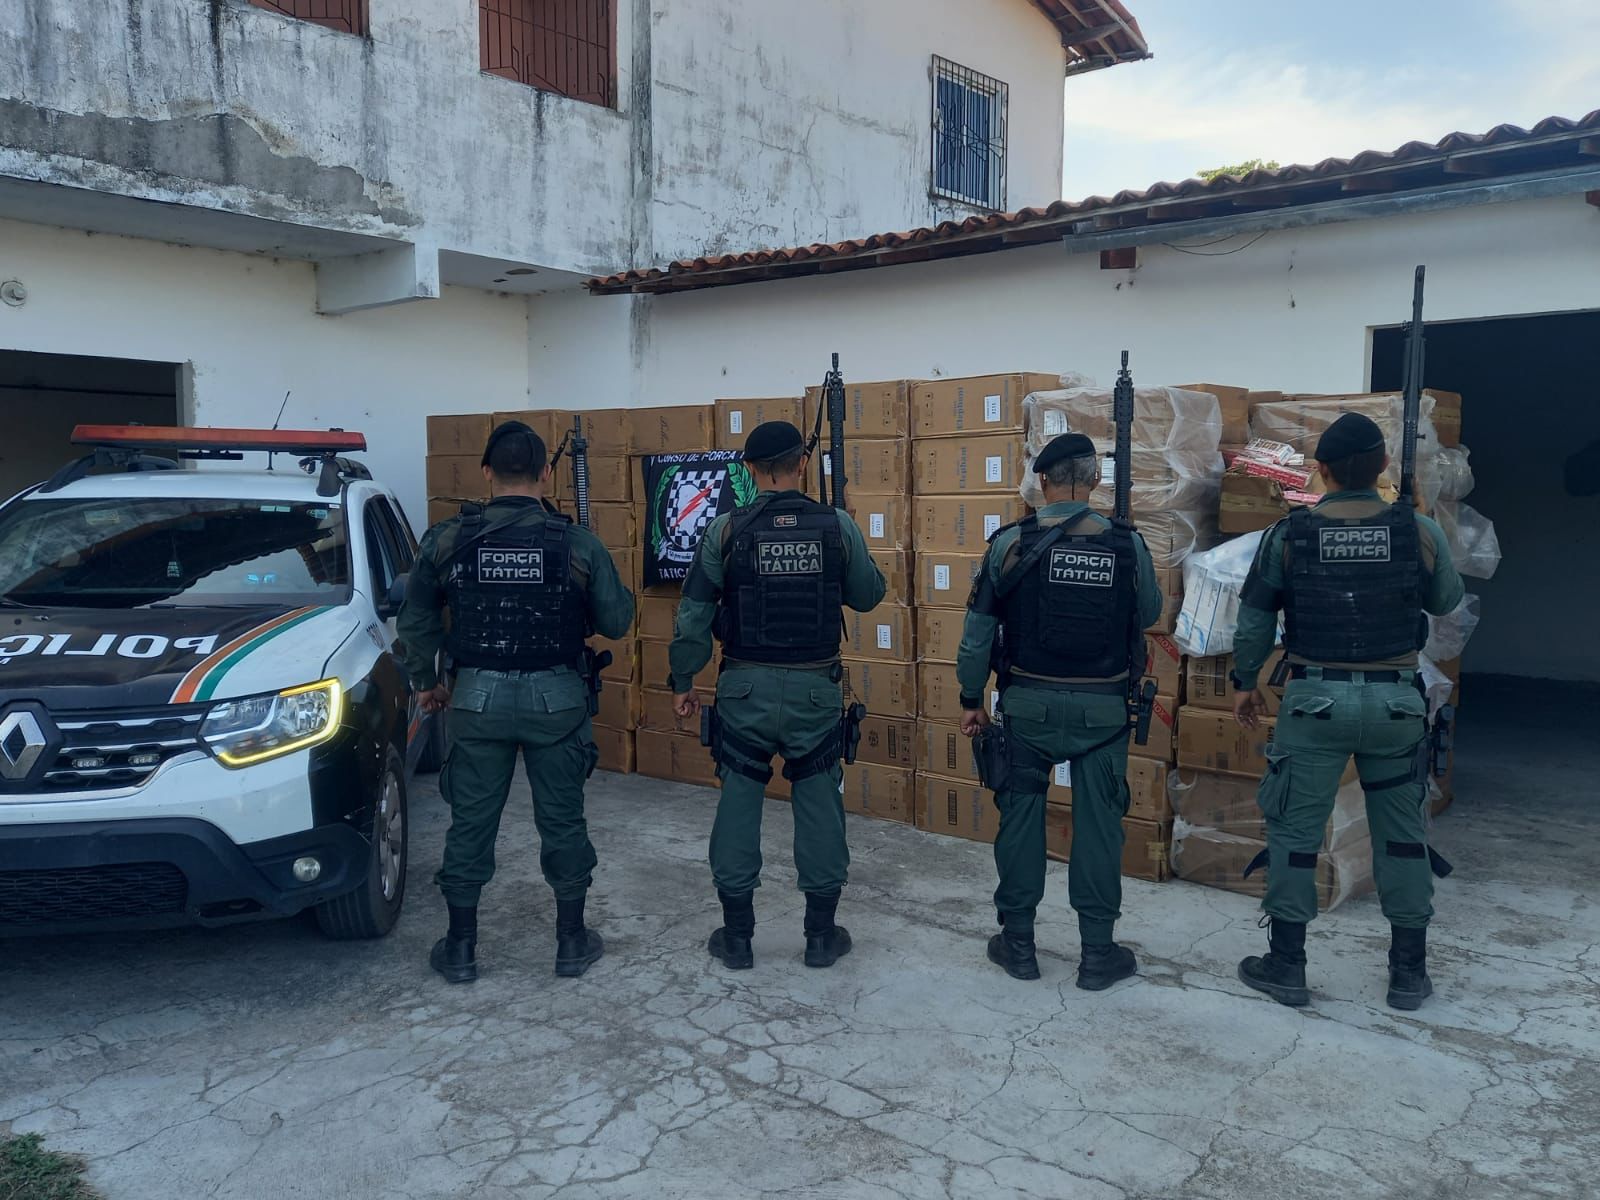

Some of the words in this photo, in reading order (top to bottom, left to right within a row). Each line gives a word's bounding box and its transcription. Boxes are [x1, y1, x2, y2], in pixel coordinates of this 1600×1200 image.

[701, 451, 736, 462] FORÇA
[1322, 530, 1387, 543] FORÇA
[761, 543, 819, 560] FORÇA
[1322, 544, 1388, 558] TÁTICA
[481, 552, 540, 564] FORÇA
[761, 557, 820, 572] TÁTICA
[481, 566, 540, 578] TÁTICA
[1052, 567, 1111, 582] TÁTICA
